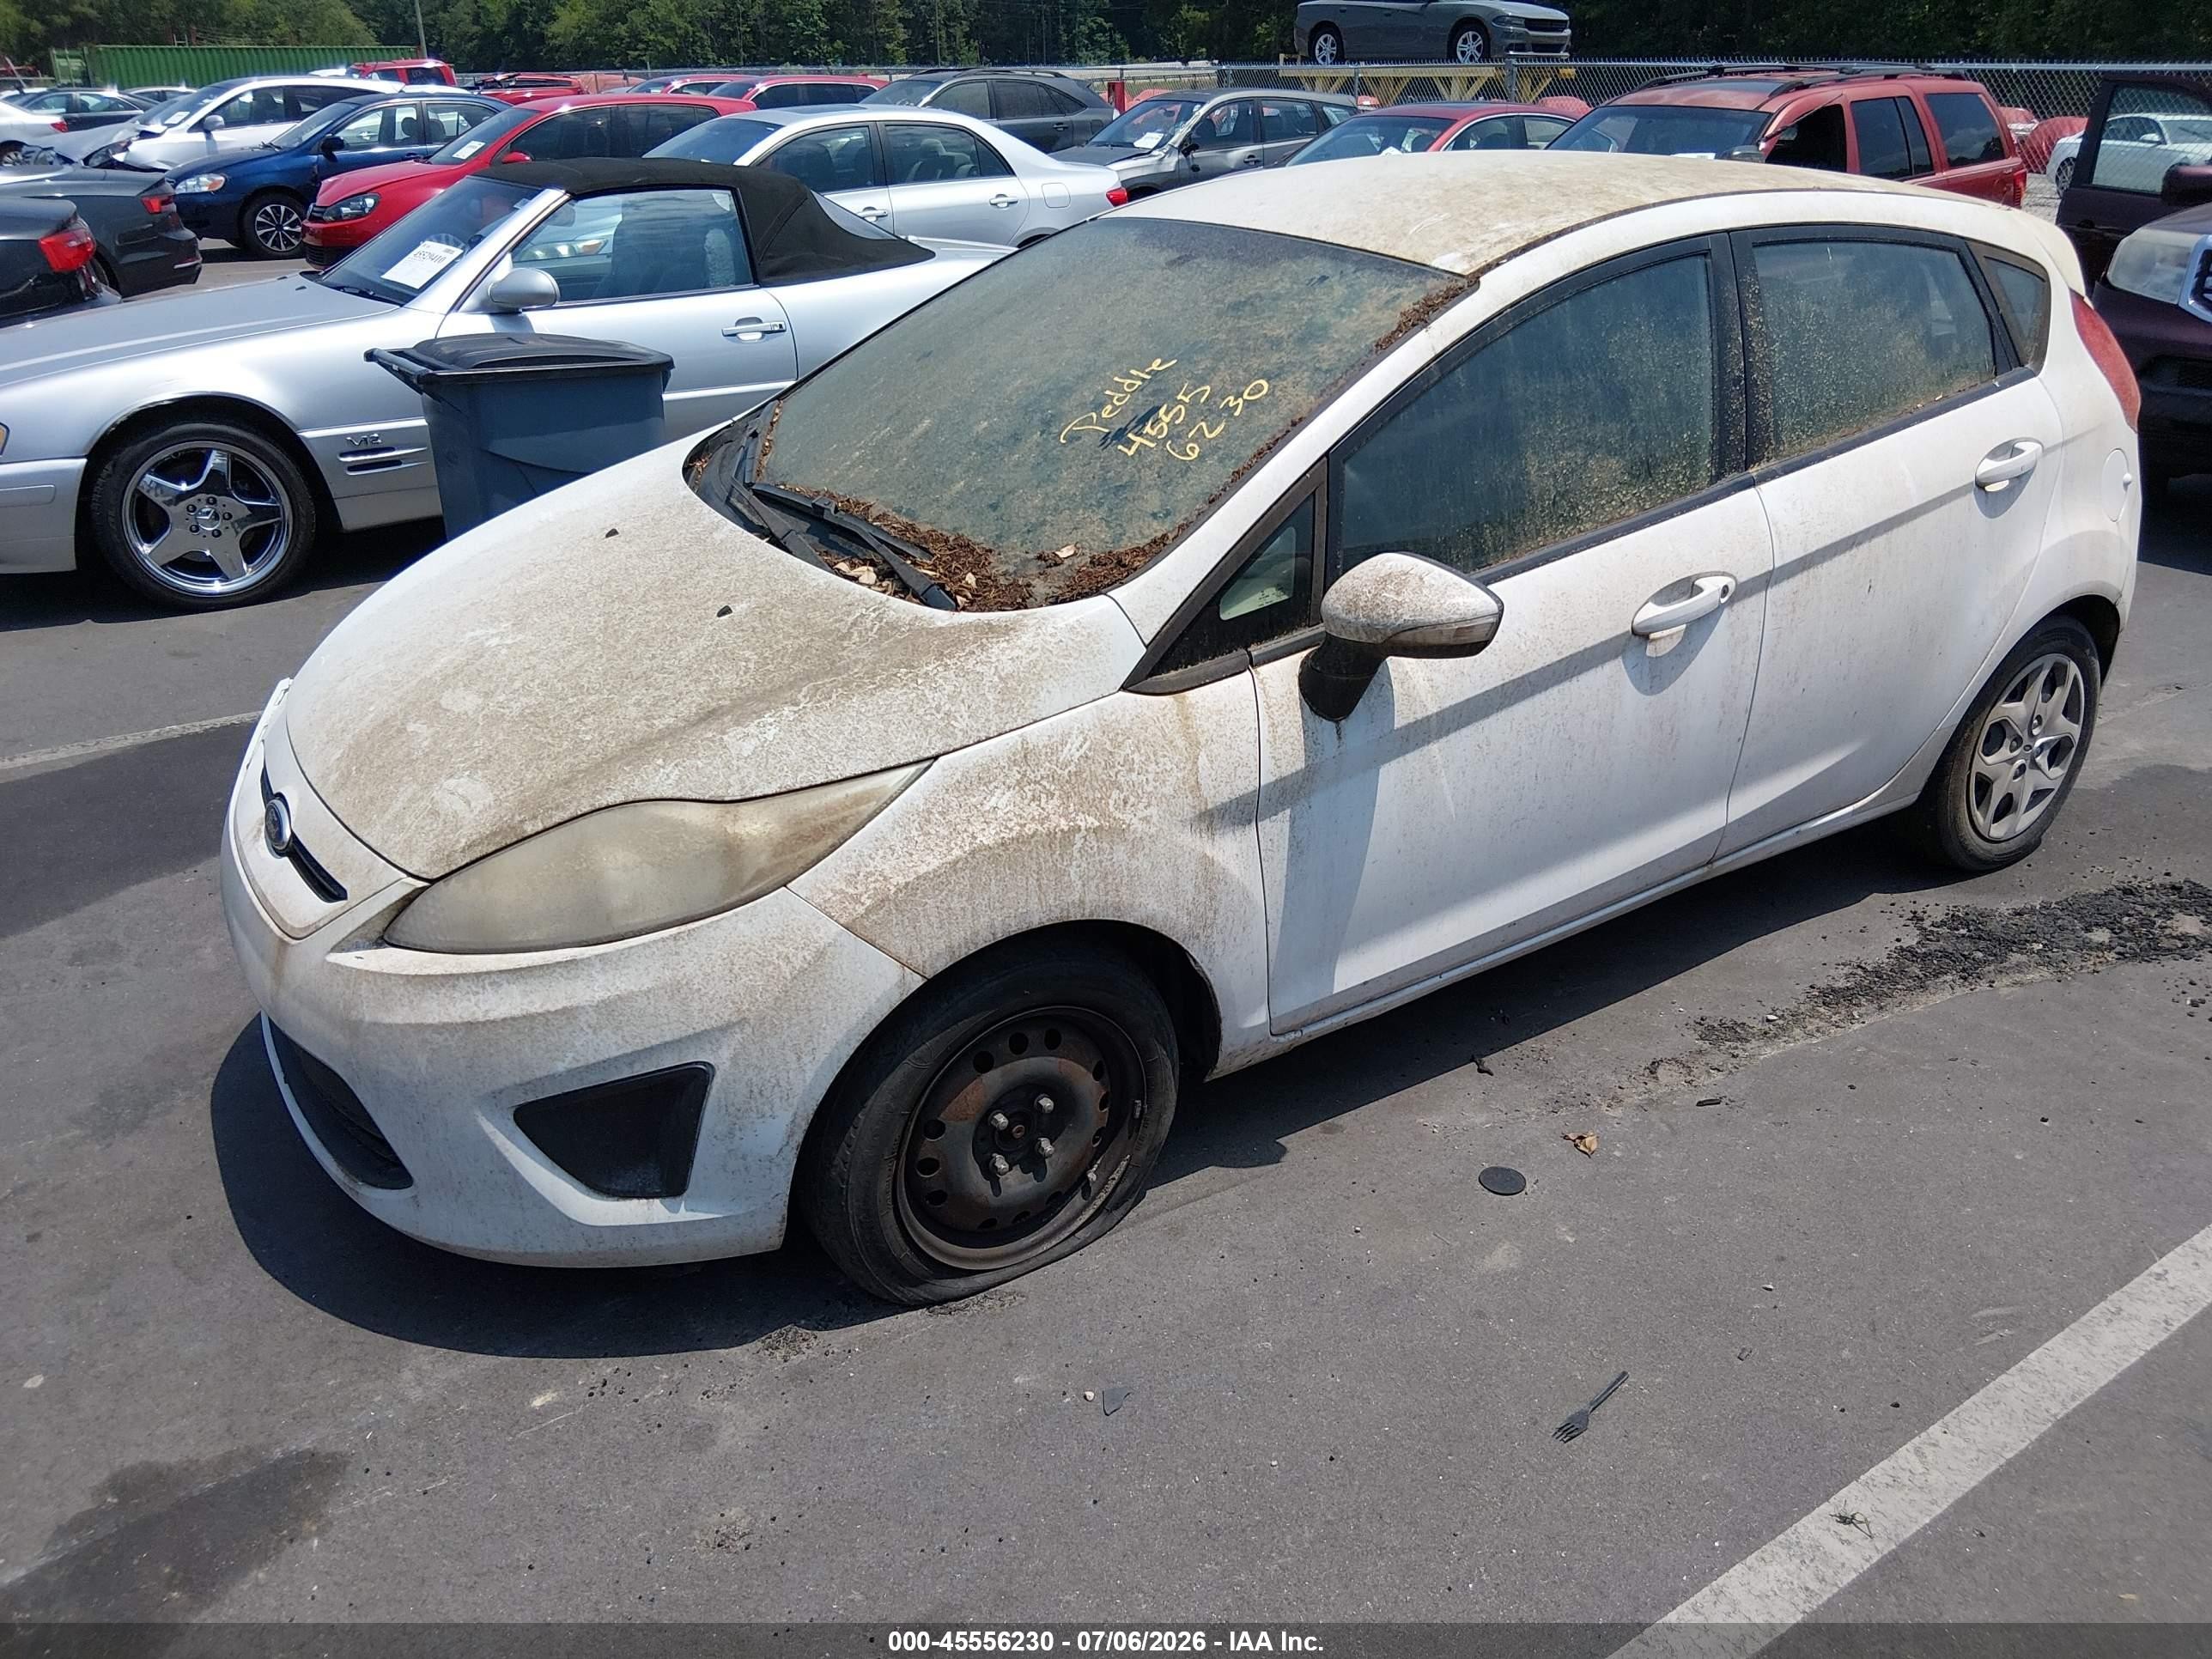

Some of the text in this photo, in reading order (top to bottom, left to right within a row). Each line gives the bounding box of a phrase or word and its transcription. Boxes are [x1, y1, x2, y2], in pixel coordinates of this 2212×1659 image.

[1060, 357, 1178, 444] Peddle
[1117, 380, 1211, 456] 4555
[1166, 379, 1269, 460] 6230
[345, 434, 383, 447] V12
